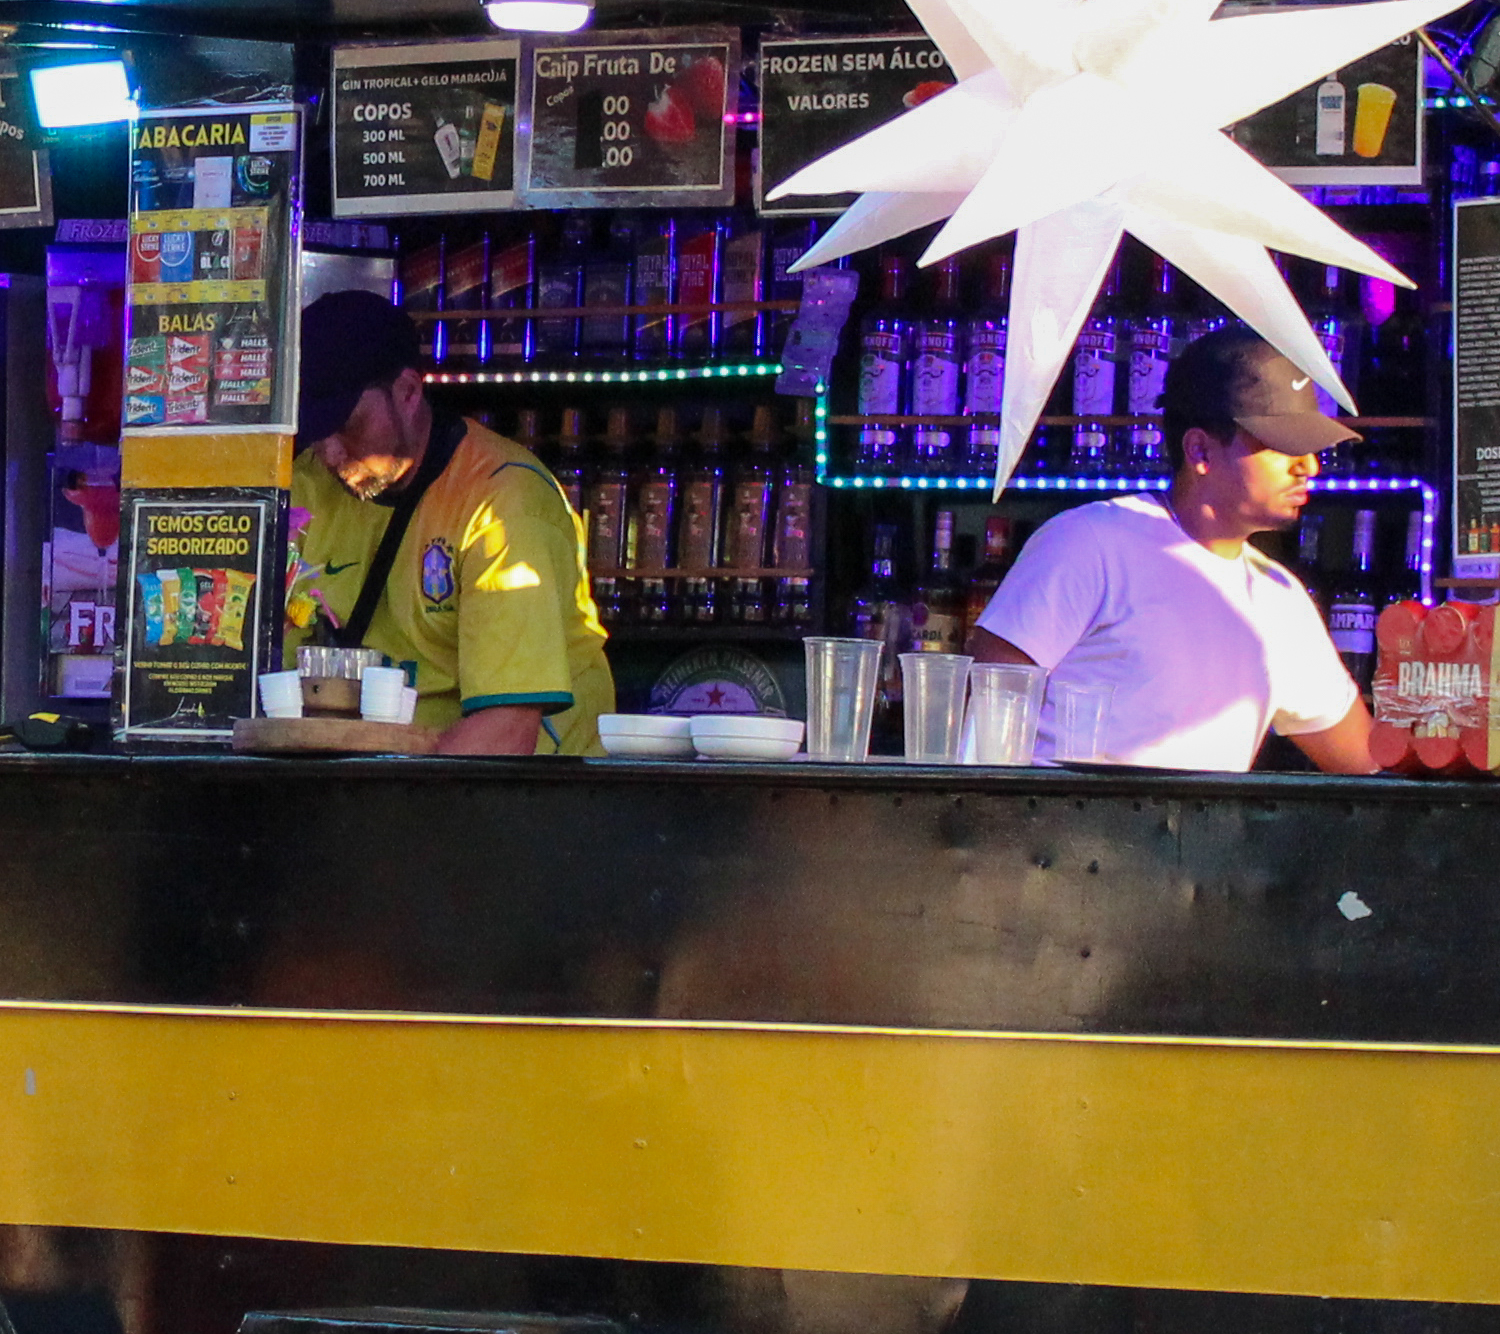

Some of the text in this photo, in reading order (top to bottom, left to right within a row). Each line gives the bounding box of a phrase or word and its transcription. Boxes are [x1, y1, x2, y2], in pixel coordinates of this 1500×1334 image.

[536, 51, 677, 83] Caip Fruta De
[761, 55, 837, 76] FROZEN
[841, 53, 882, 73] SEM
[342, 79, 361, 91] GIN
[421, 74, 449, 87] GELO
[788, 92, 870, 112] VALORES
[353, 102, 413, 122] COPOS
[362, 128, 406, 143] 300 ML
[362, 151, 406, 165] 500 ML
[363, 173, 406, 187] 700 ML
[158, 312, 216, 333] BALAS
[240, 338, 269, 348] HALLS
[240, 353, 268, 362] HALLS
[239, 368, 267, 377] HALLS
[219, 380, 246, 390] HALLS
[220, 393, 246, 402] HALLS
[147, 515, 251, 534] TEMOS GELO
[147, 537, 249, 556] SABORIZADO
[656, 647, 715, 699] HEINEKEN
[1397, 661, 1483, 698] BRAHMA
